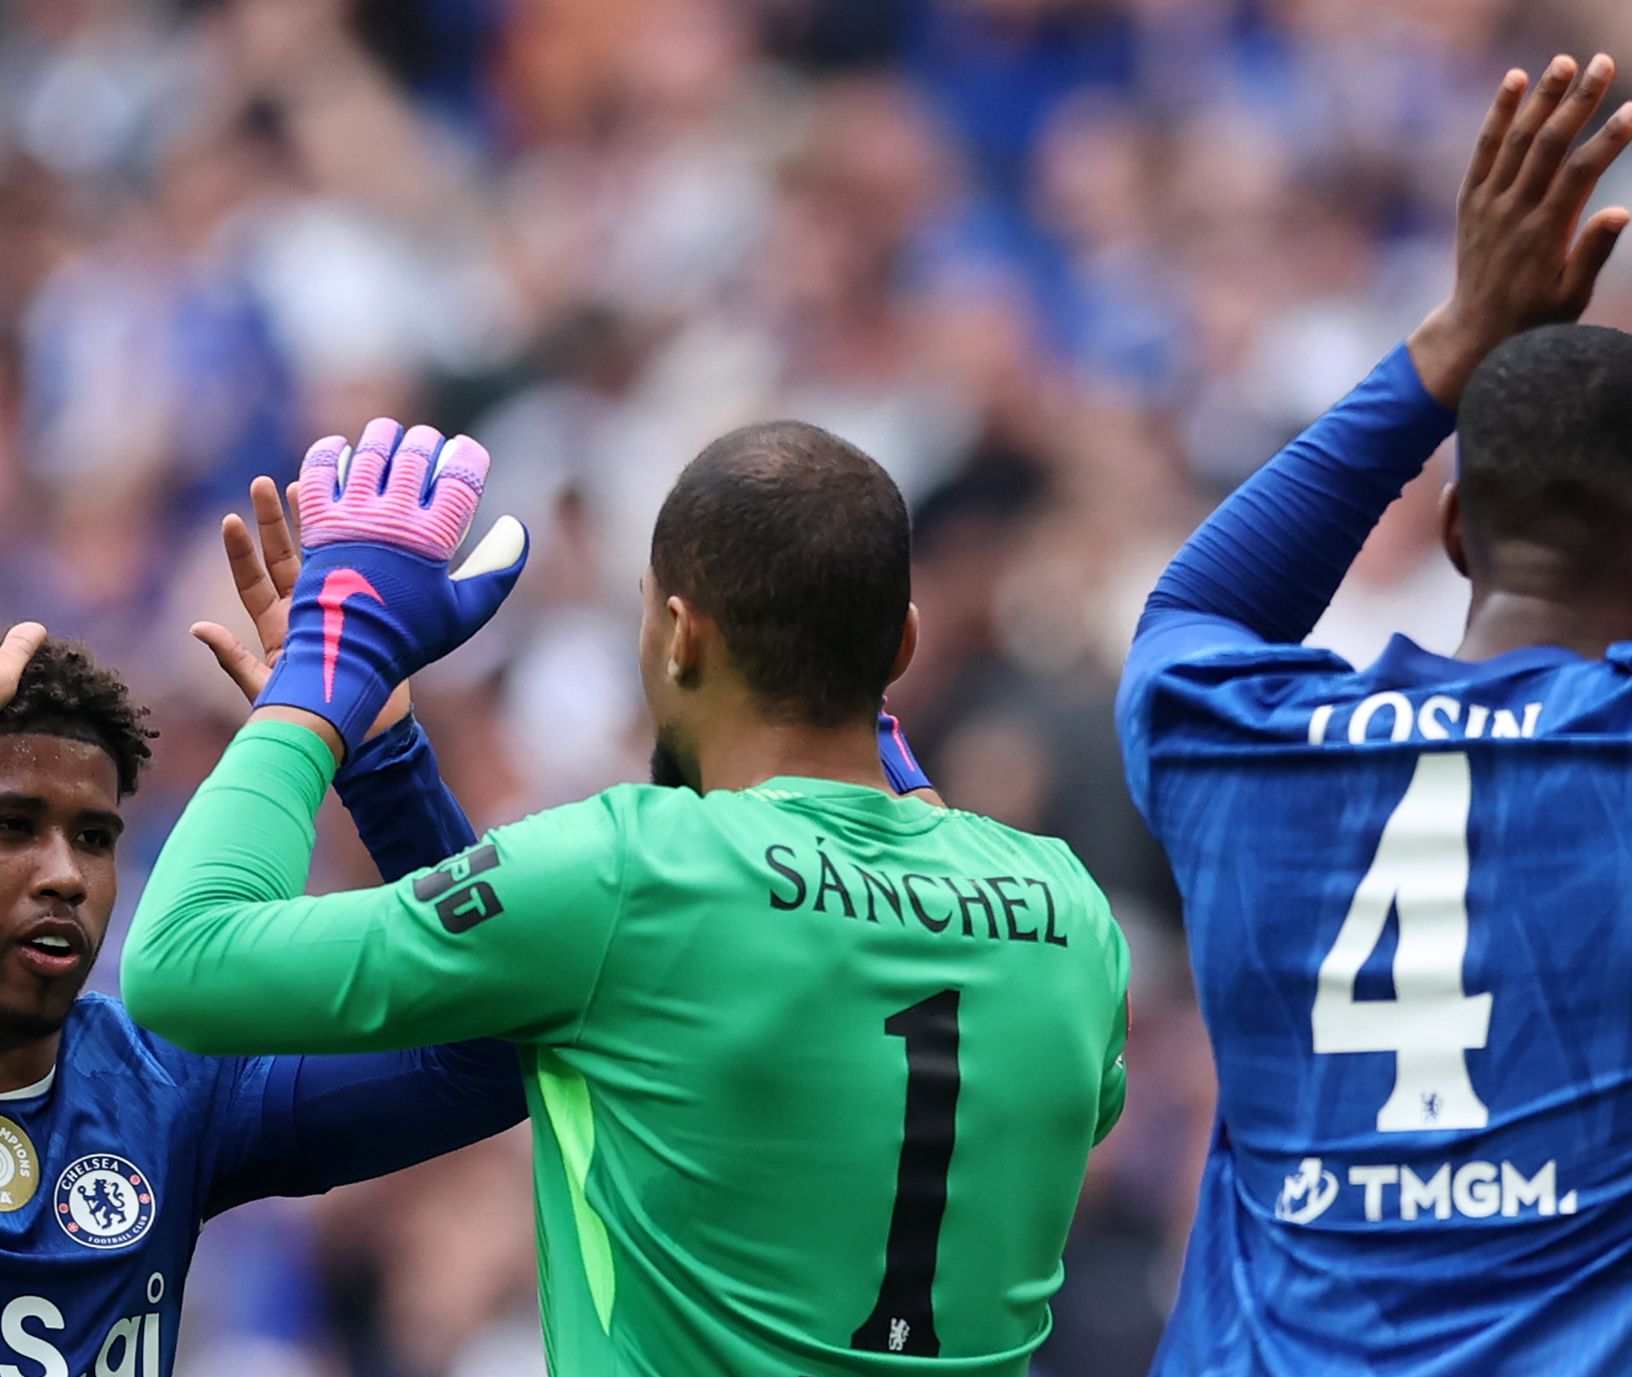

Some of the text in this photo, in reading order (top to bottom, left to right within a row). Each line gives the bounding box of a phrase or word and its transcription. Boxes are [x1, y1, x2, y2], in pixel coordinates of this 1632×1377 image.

[765, 836, 1069, 948] SÁNCHEZ
[1312, 751, 1493, 1133] 4
[61, 1157, 120, 1191] CHELSEA
[88, 1214, 148, 1245] FOOTBALL CLUB
[850, 987, 963, 1360] 1
